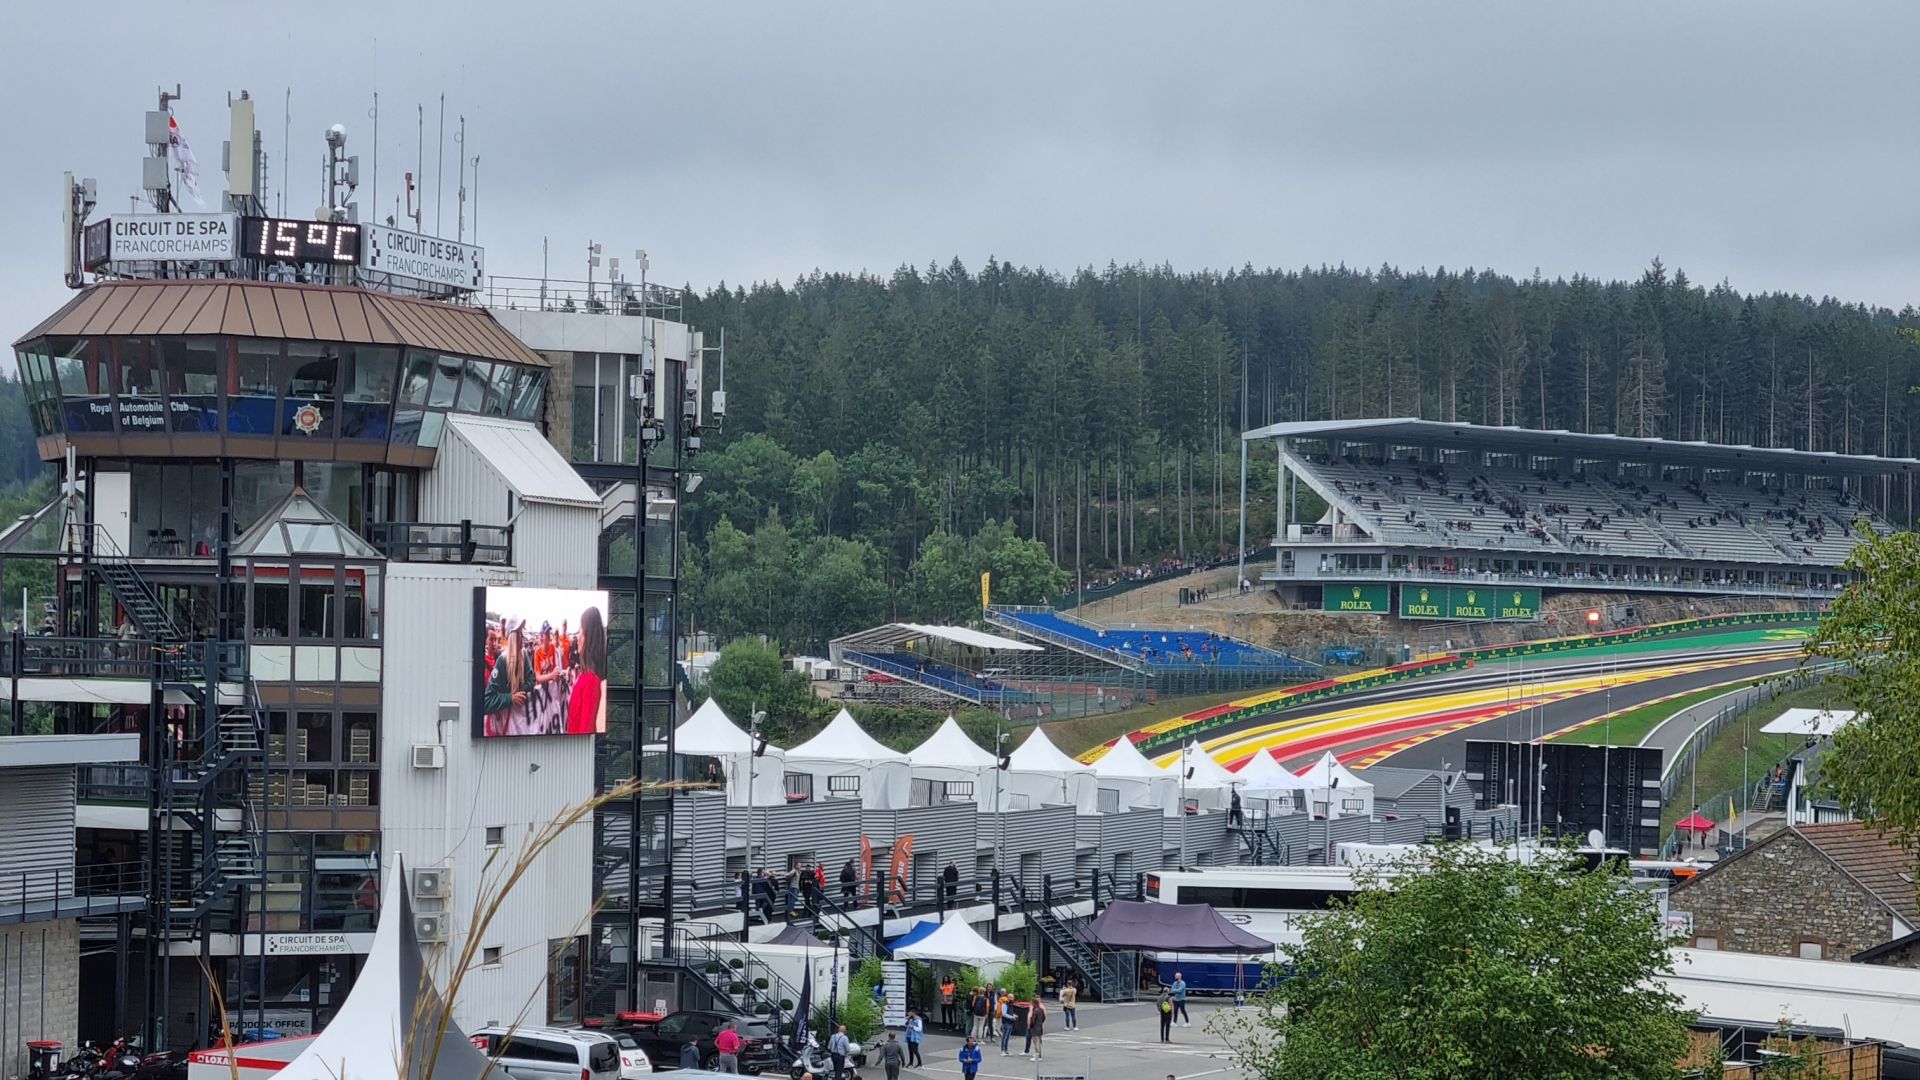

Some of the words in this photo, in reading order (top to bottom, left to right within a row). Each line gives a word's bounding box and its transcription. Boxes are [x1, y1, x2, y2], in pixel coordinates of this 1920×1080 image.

[115, 221, 172, 236] CIRCUIT
[176, 221, 195, 236] DE
[199, 220, 228, 235] SPA
[115, 239, 228, 253] FRANCORCHAMPS
[387, 232, 427, 256] CIRCUIT
[430, 241, 443, 260] DE
[445, 244, 465, 264] SPA
[387, 254, 465, 284] FRANCORCHAMPS
[90, 402, 112, 416] Royal
[120, 401, 163, 412] Automobile
[170, 401, 189, 412] Club
[122, 415, 130, 425] of
[132, 415, 164, 428] Belgium
[1341, 600, 1372, 610] ROLEX
[1408, 604, 1440, 615] ROLEX
[1455, 606, 1486, 617] ROLEX
[1502, 608, 1531, 618] ROLEX
[280, 935, 313, 944] CIRCUIT
[315, 935, 326, 944] DE
[328, 935, 345, 944] SPA
[280, 944, 345, 953] FRANCORCHAMPS
[274, 1020, 305, 1029] OFFICE
